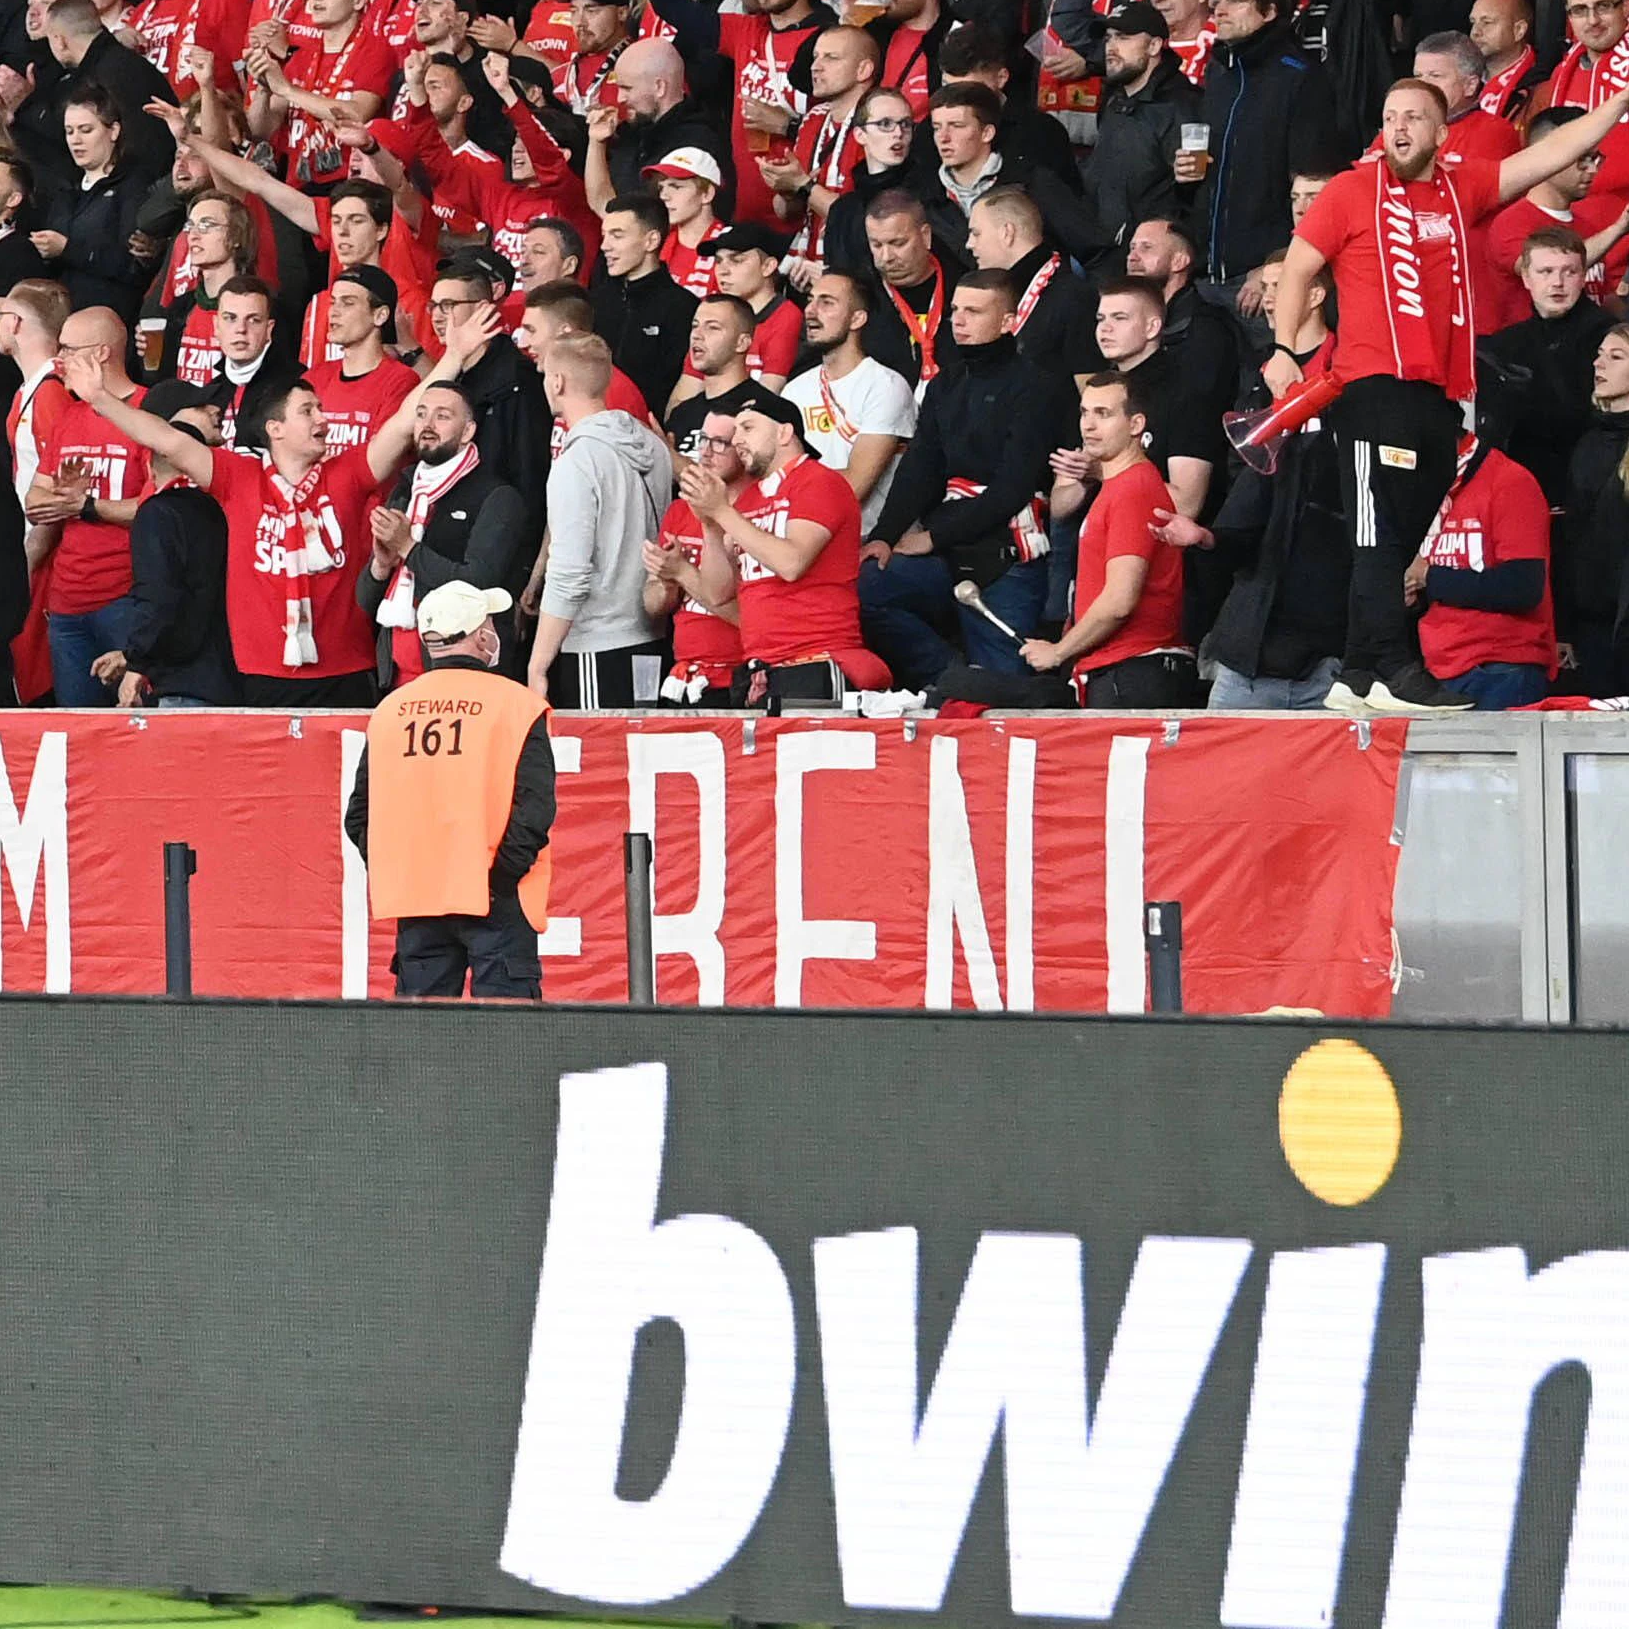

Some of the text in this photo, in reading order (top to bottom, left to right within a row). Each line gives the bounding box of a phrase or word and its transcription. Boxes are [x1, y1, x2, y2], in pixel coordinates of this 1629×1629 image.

[1383, 182, 1428, 320] Union
[1435, 533, 1466, 555] ZUM
[397, 698, 483, 719] STEWARD
[402, 718, 464, 758] 161
[499, 1039, 1629, 1629] bwin
